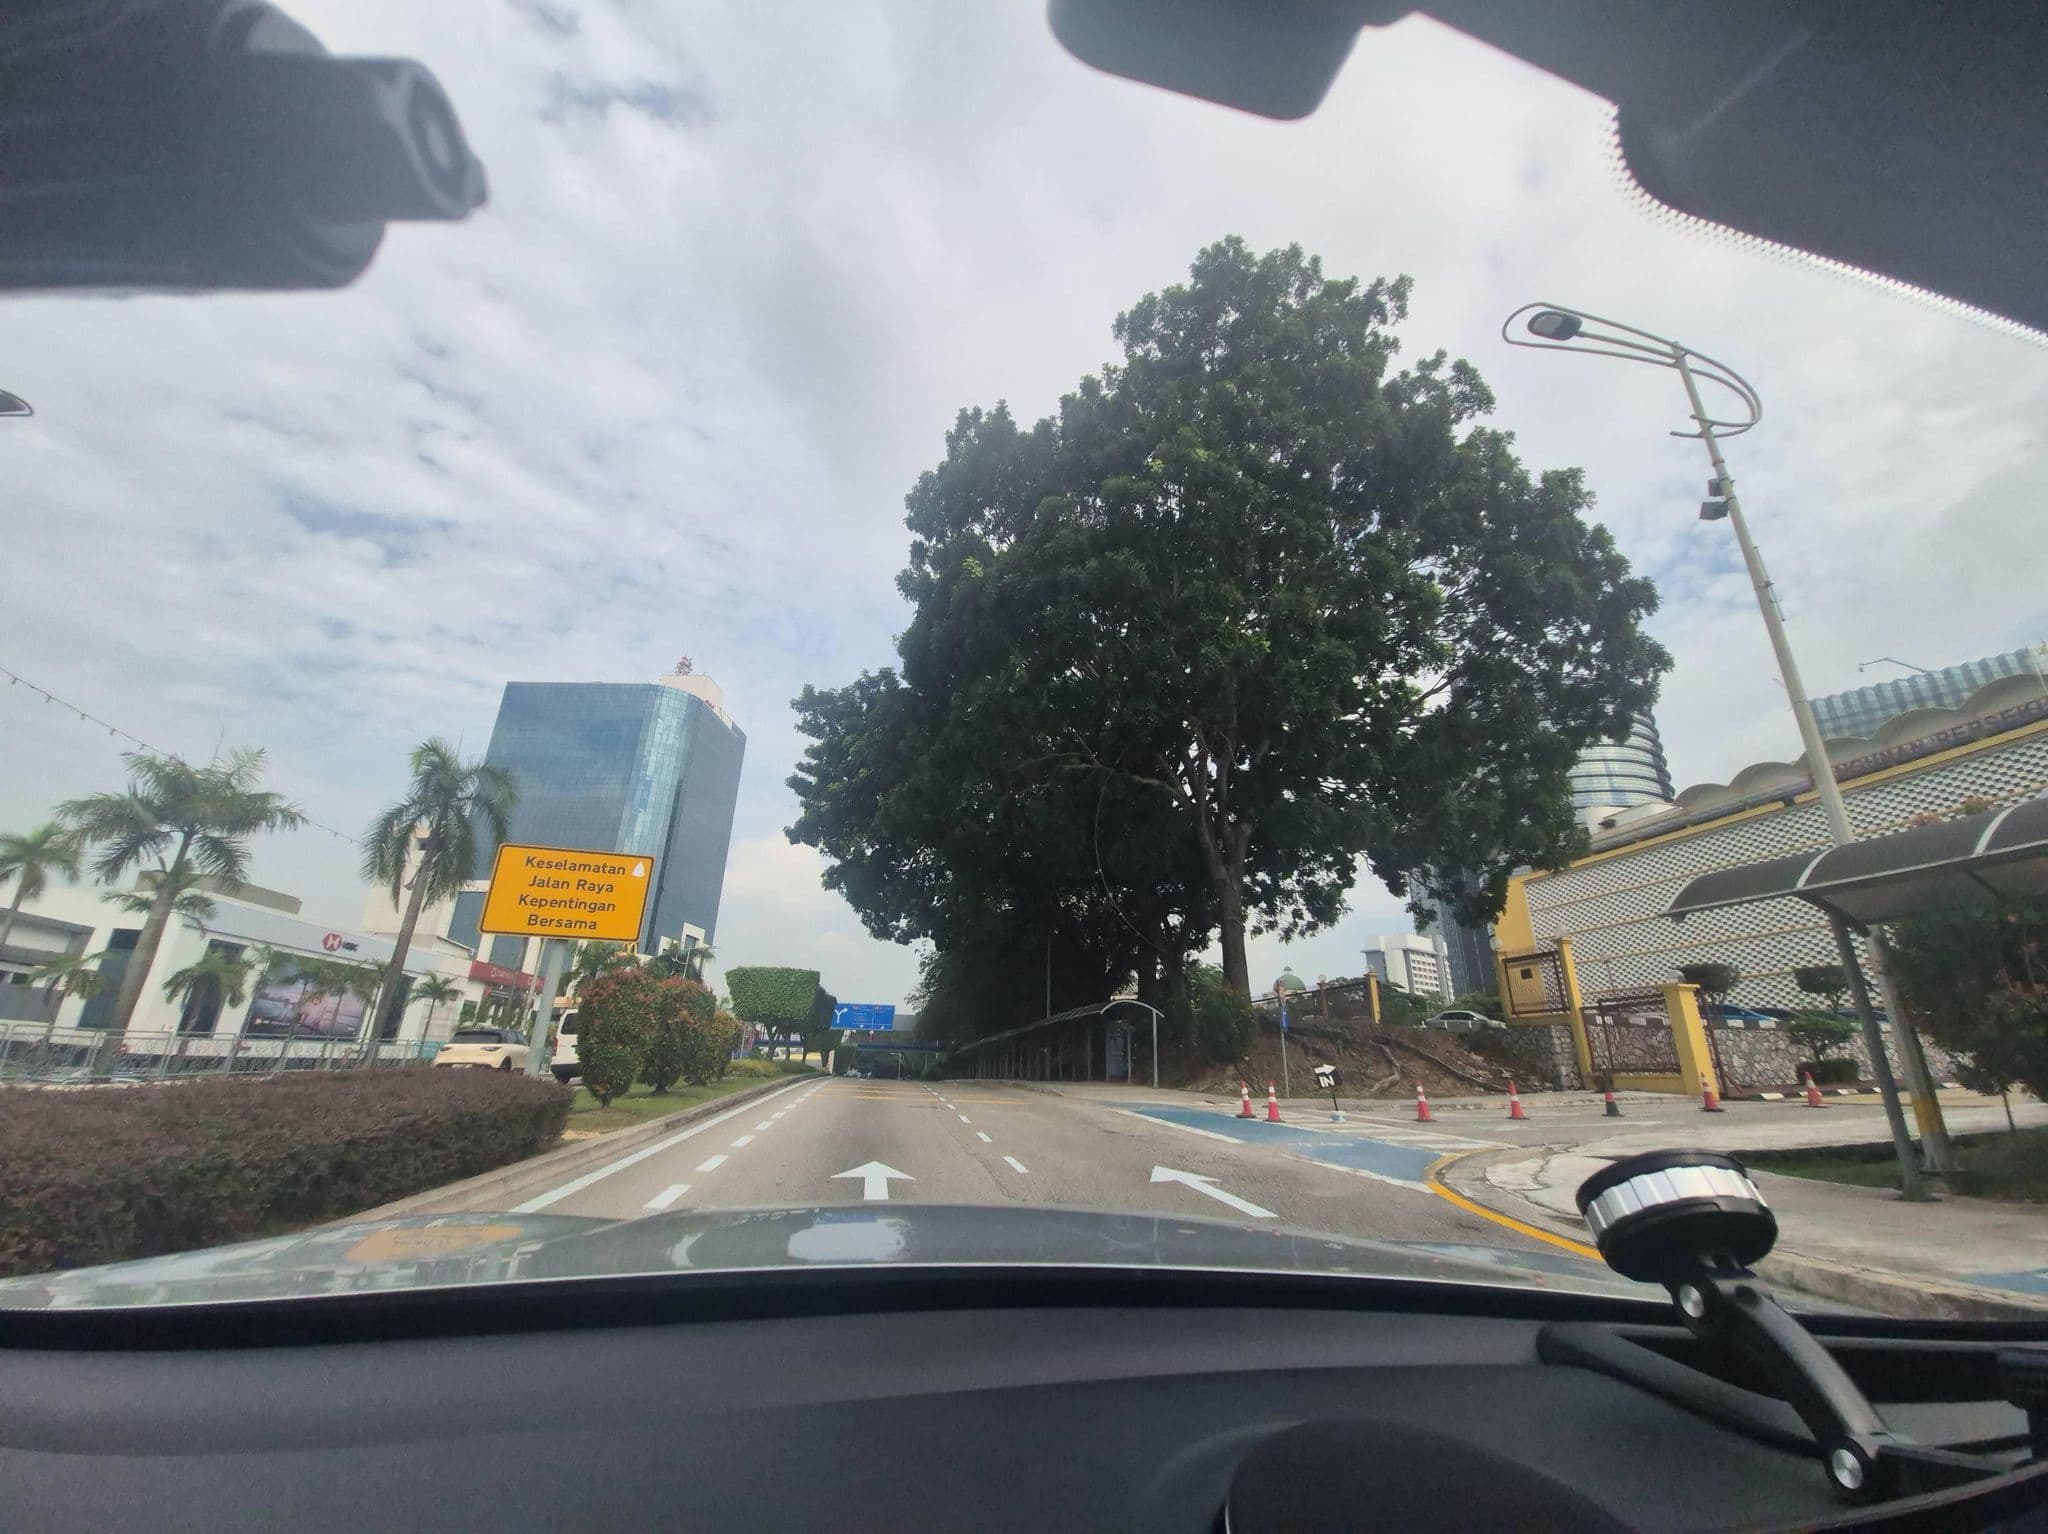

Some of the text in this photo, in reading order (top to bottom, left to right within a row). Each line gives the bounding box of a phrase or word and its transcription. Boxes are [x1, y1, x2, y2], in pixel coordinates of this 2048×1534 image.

[525, 856, 626, 875] Keselamatan
[528, 875, 614, 895] Jalan Raya
[518, 893, 616, 913] Kepentingan
[527, 914, 597, 930] Bersama
[1318, 1075, 1335, 1088] IN
